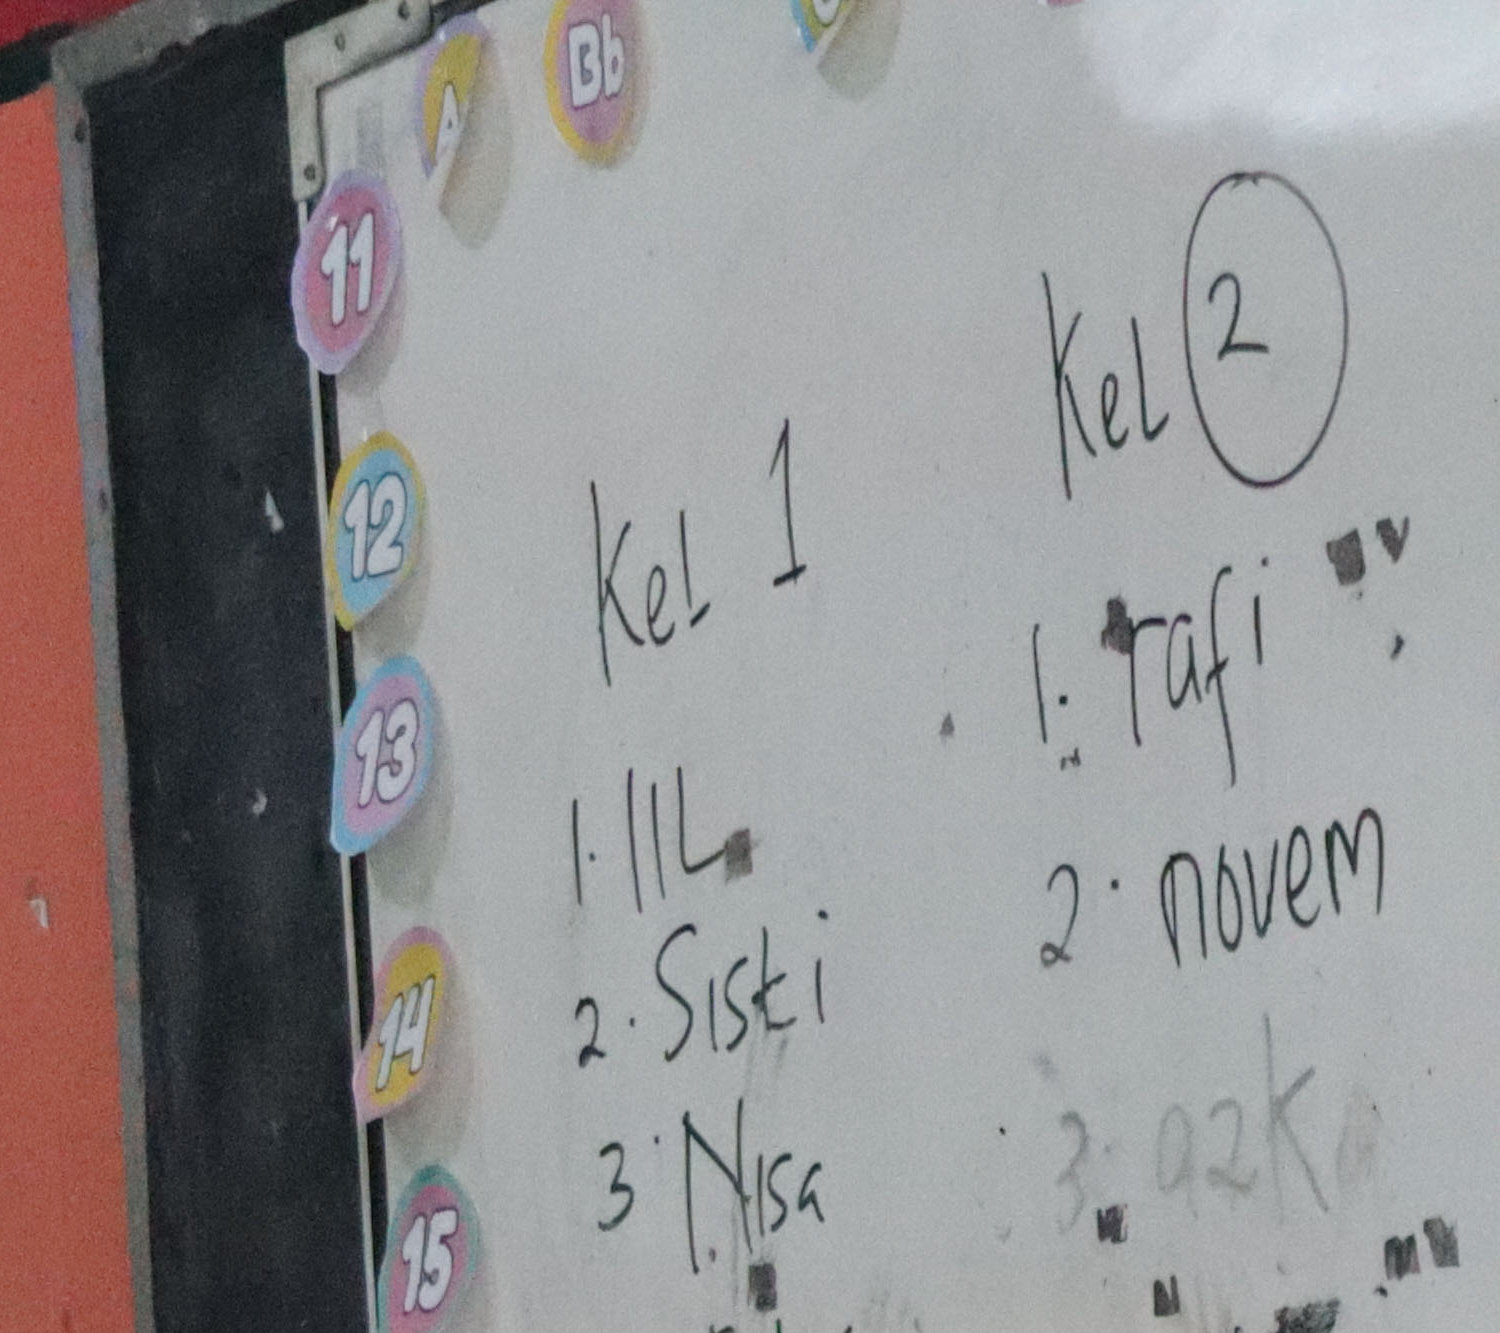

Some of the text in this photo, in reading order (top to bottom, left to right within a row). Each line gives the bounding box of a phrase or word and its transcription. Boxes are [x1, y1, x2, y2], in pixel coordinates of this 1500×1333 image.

[566, 12, 627, 111] Bb
[319, 210, 377, 329] 11
[1207, 271, 1270, 361] 2
[343, 471, 408, 581] 12
[766, 416, 807, 587] 1
[354, 696, 420, 809] 13
[374, 972, 436, 1093] 14
[400, 1206, 460, 1314] 15
